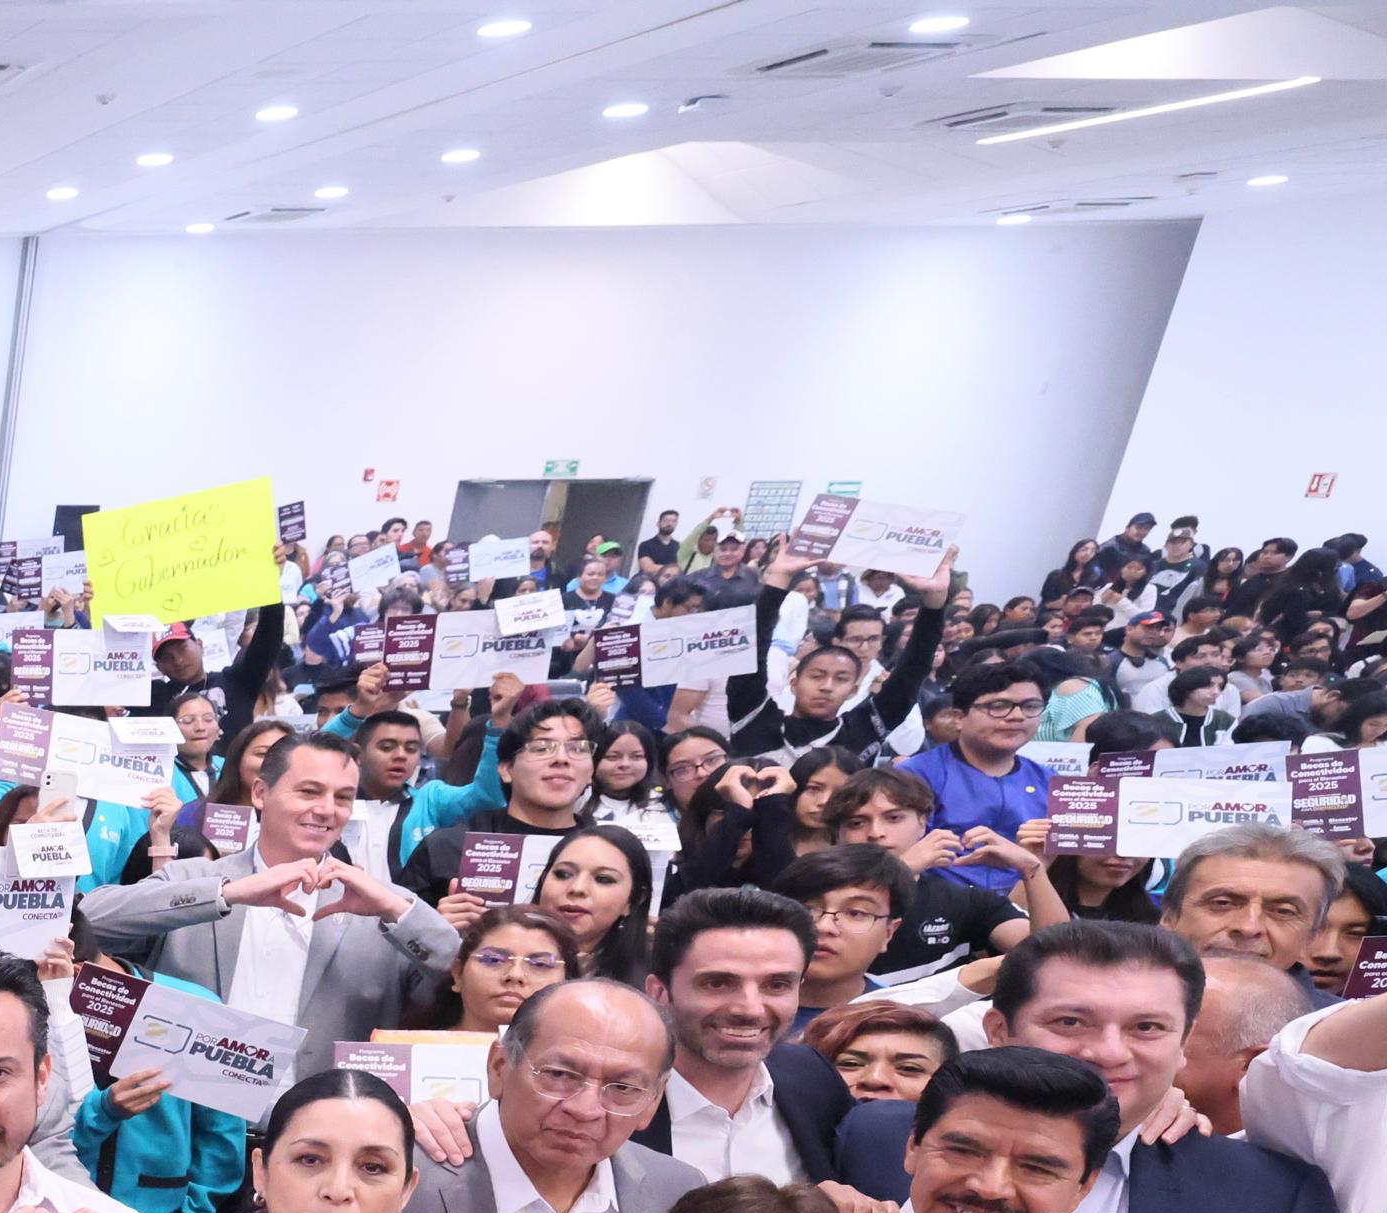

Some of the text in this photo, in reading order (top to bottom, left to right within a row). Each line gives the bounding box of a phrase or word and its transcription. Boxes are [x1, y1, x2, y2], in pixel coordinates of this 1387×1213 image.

[123, 505, 225, 549] Gracias
[886, 531, 943, 548] PUEBLA
[115, 538, 248, 598] Gobernador
[482, 638, 545, 652] PUEBLA
[687, 635, 749, 652] PUEBLA
[94, 661, 146, 672] PUEBLA
[1308, 781, 1338, 791] 2025
[1068, 801, 1097, 810] 2025
[1211, 803, 1268, 812] AMOR
[1188, 811, 1281, 824] PUEBLA
[32, 852, 72, 861] PUEBLA
[10, 879, 56, 892] AMOR
[91, 977, 117, 991] Becas
[79, 982, 136, 1005] Conectividad
[87, 1000, 114, 1015] 2025
[196, 1033, 270, 1061] POR AMOR
[189, 1041, 274, 1079] PUEBLA
[222, 1069, 263, 1086] CONECTA
